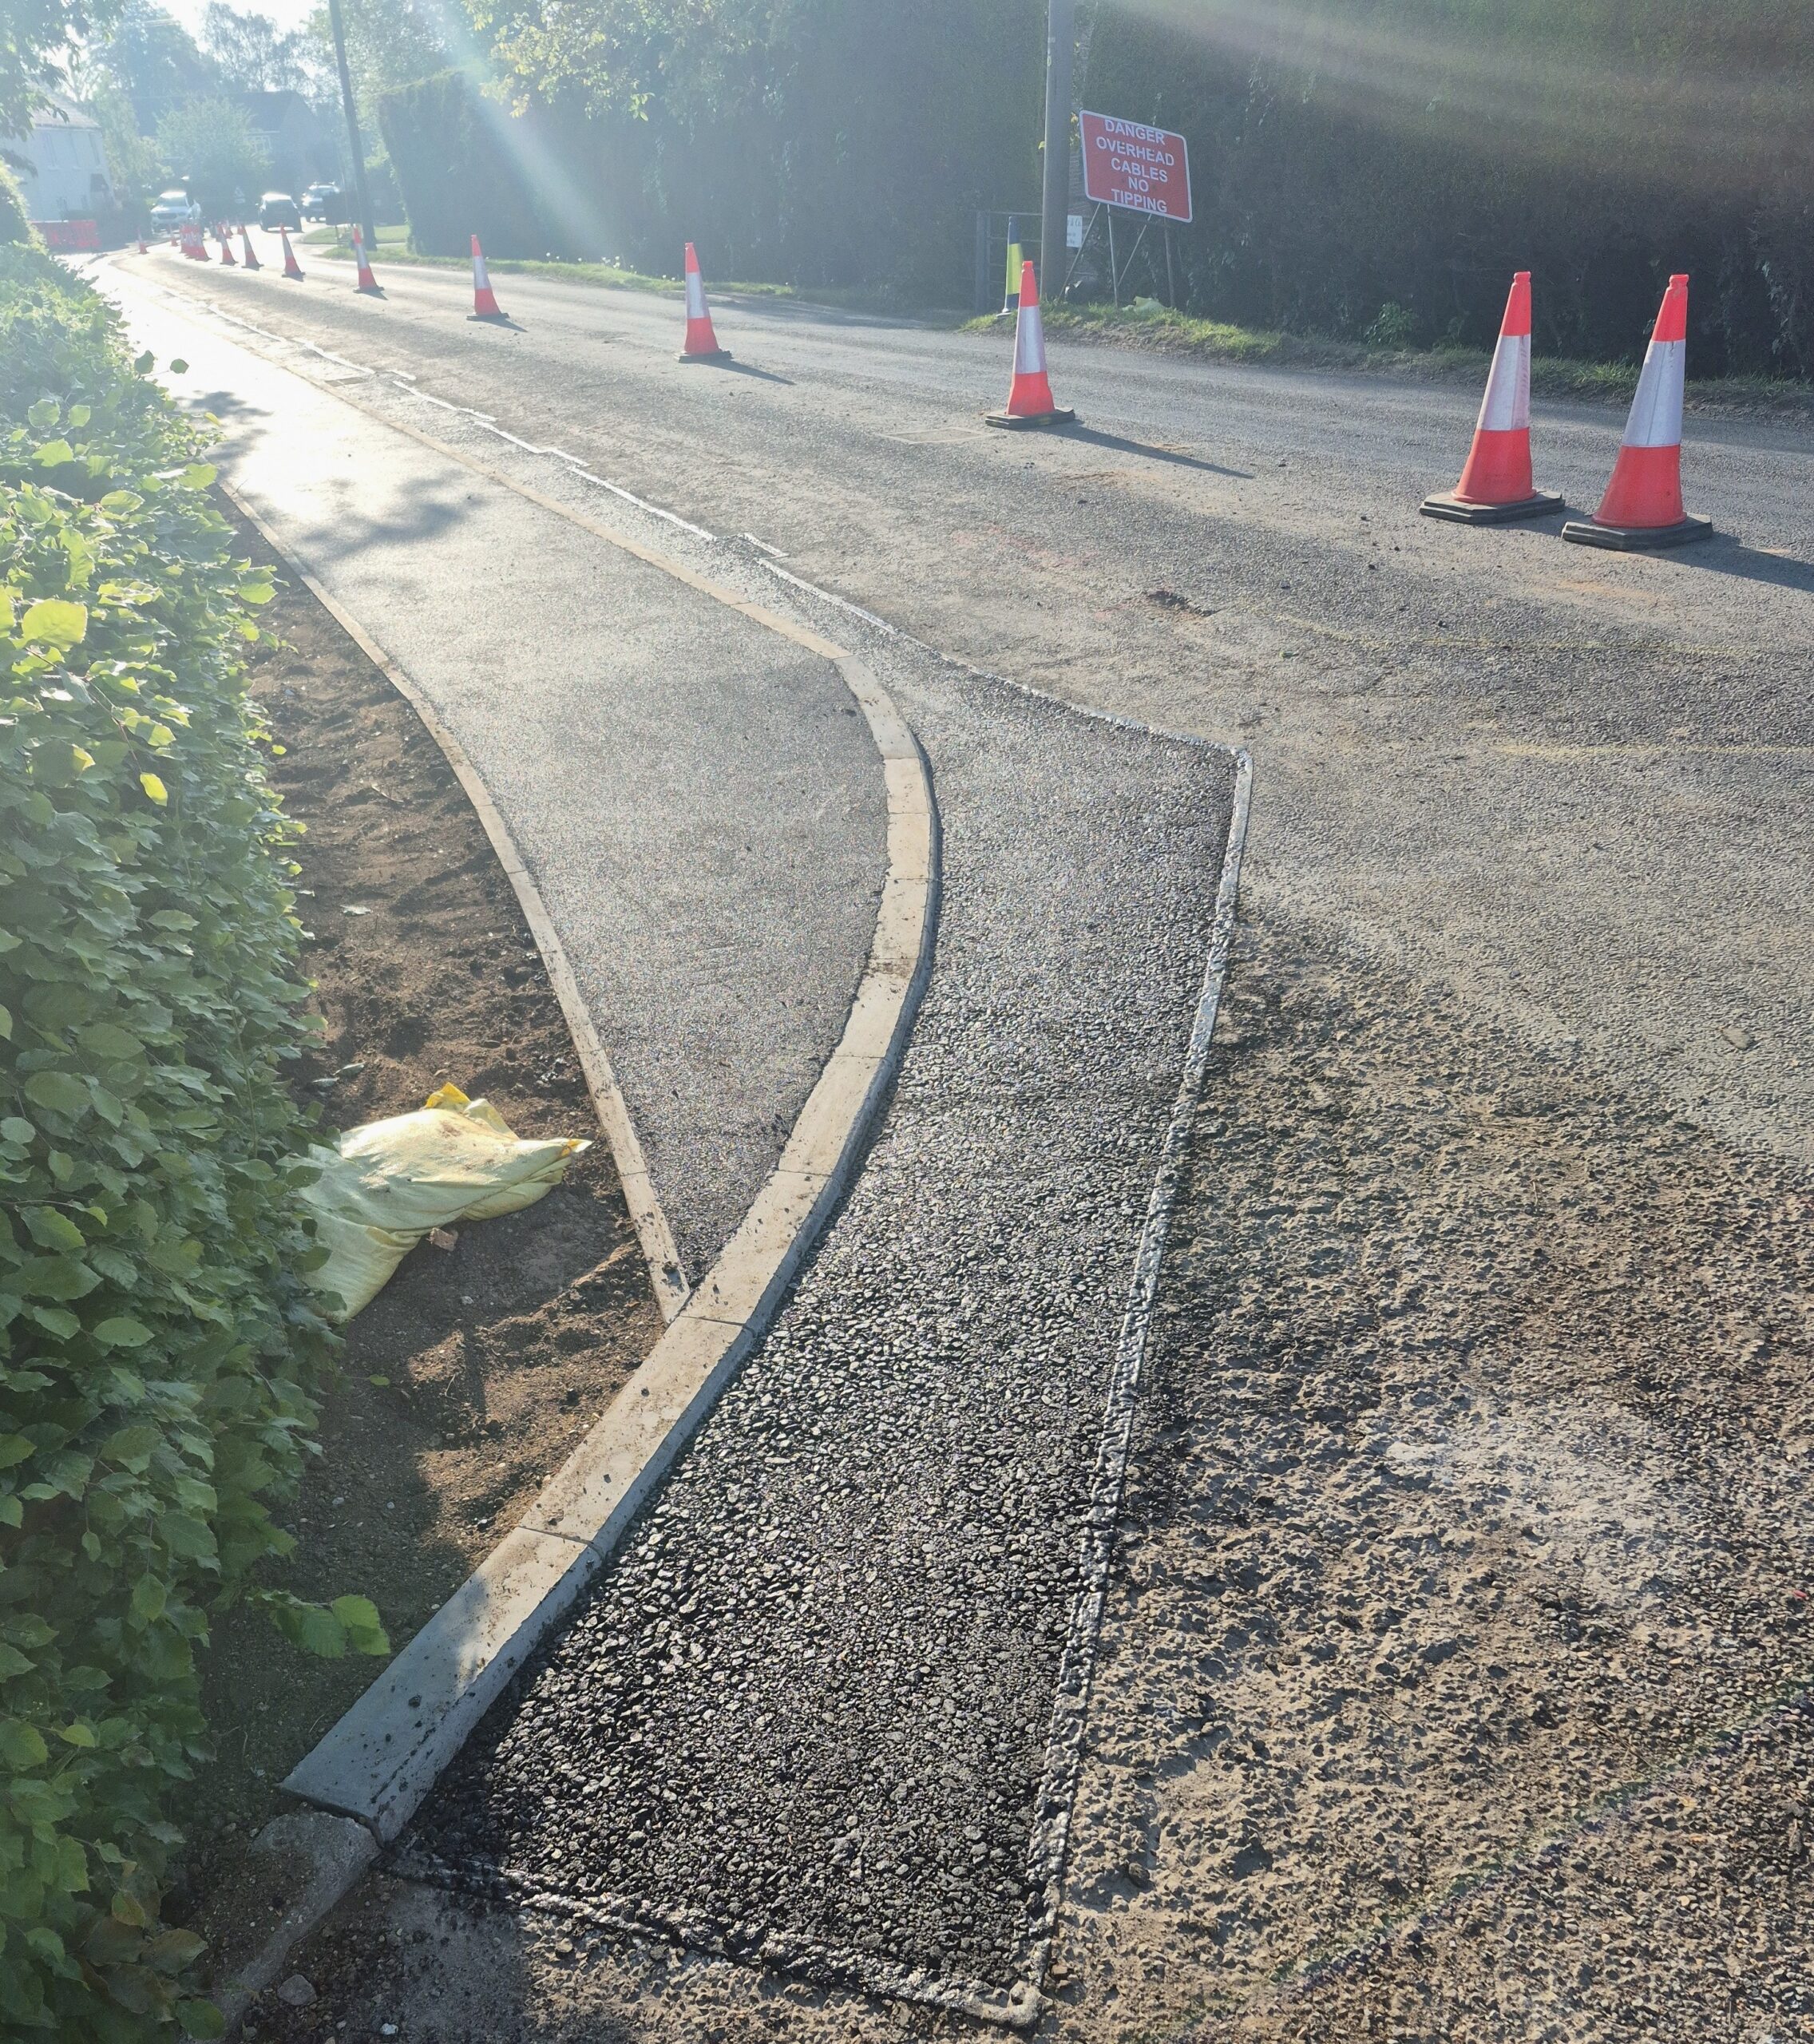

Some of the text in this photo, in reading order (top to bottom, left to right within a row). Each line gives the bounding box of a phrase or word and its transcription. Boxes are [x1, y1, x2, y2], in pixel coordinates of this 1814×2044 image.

[1105, 120, 1166, 145] DANGER
[1096, 137, 1174, 166] OVERHEAD
[1111, 157, 1168, 183] CABLES
[1128, 176, 1149, 192] NO
[1111, 188, 1167, 213] TIPPING
